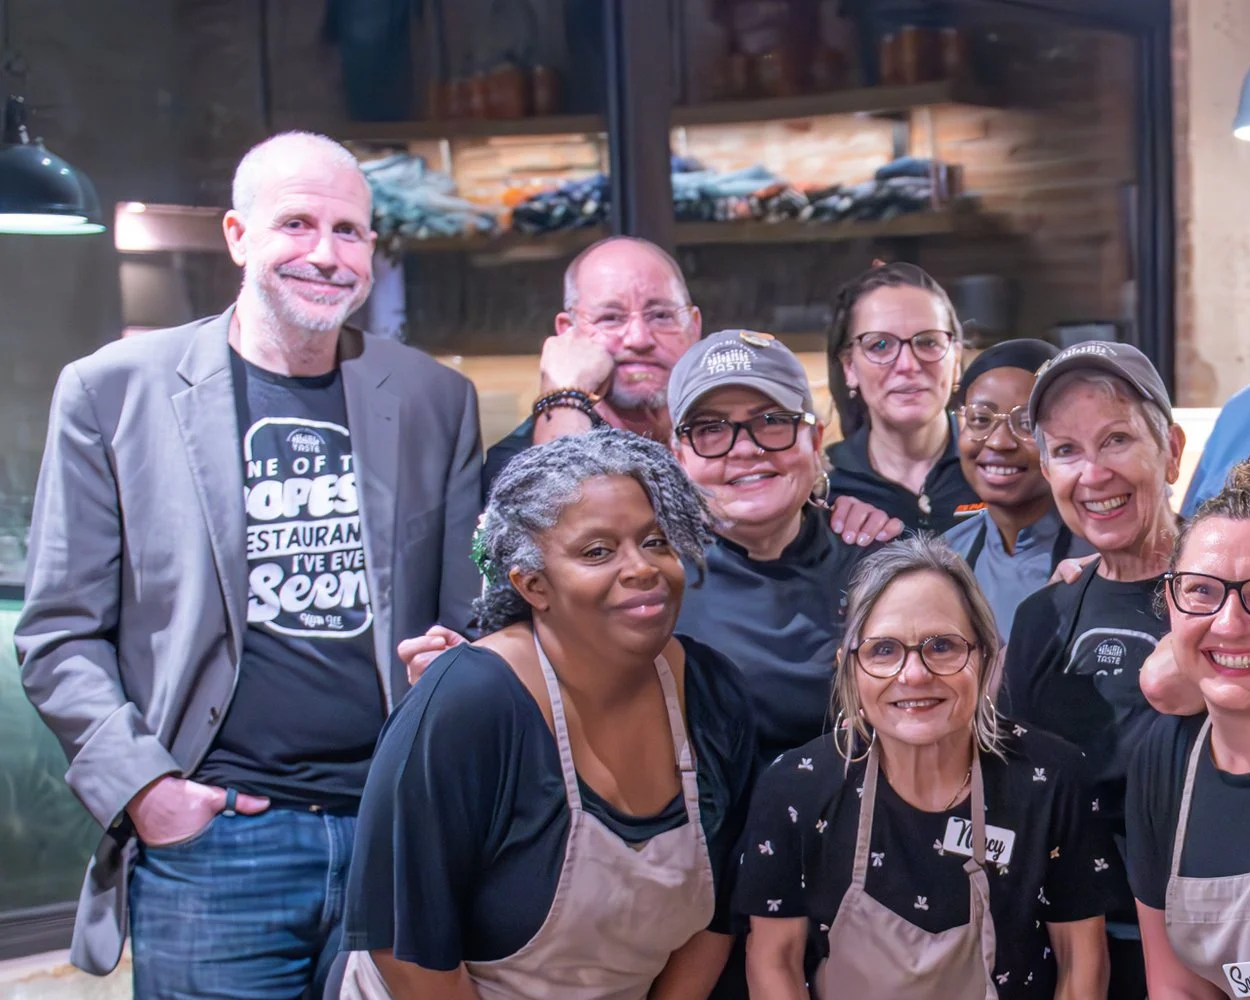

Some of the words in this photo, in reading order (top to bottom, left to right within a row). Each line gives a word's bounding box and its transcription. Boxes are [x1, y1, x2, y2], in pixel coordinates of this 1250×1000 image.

[707, 361, 752, 375] TASTE
[247, 458, 278, 478] NE
[293, 455, 326, 475] OF
[340, 455, 352, 471] T
[244, 472, 360, 520] OPES
[247, 523, 361, 552] ESTAURAN
[292, 554, 325, 573] I'VE
[330, 550, 364, 571] EVE
[247, 562, 369, 622] Seen
[1097, 655, 1120, 665] TASTE
[953, 818, 1006, 861] Ncy
